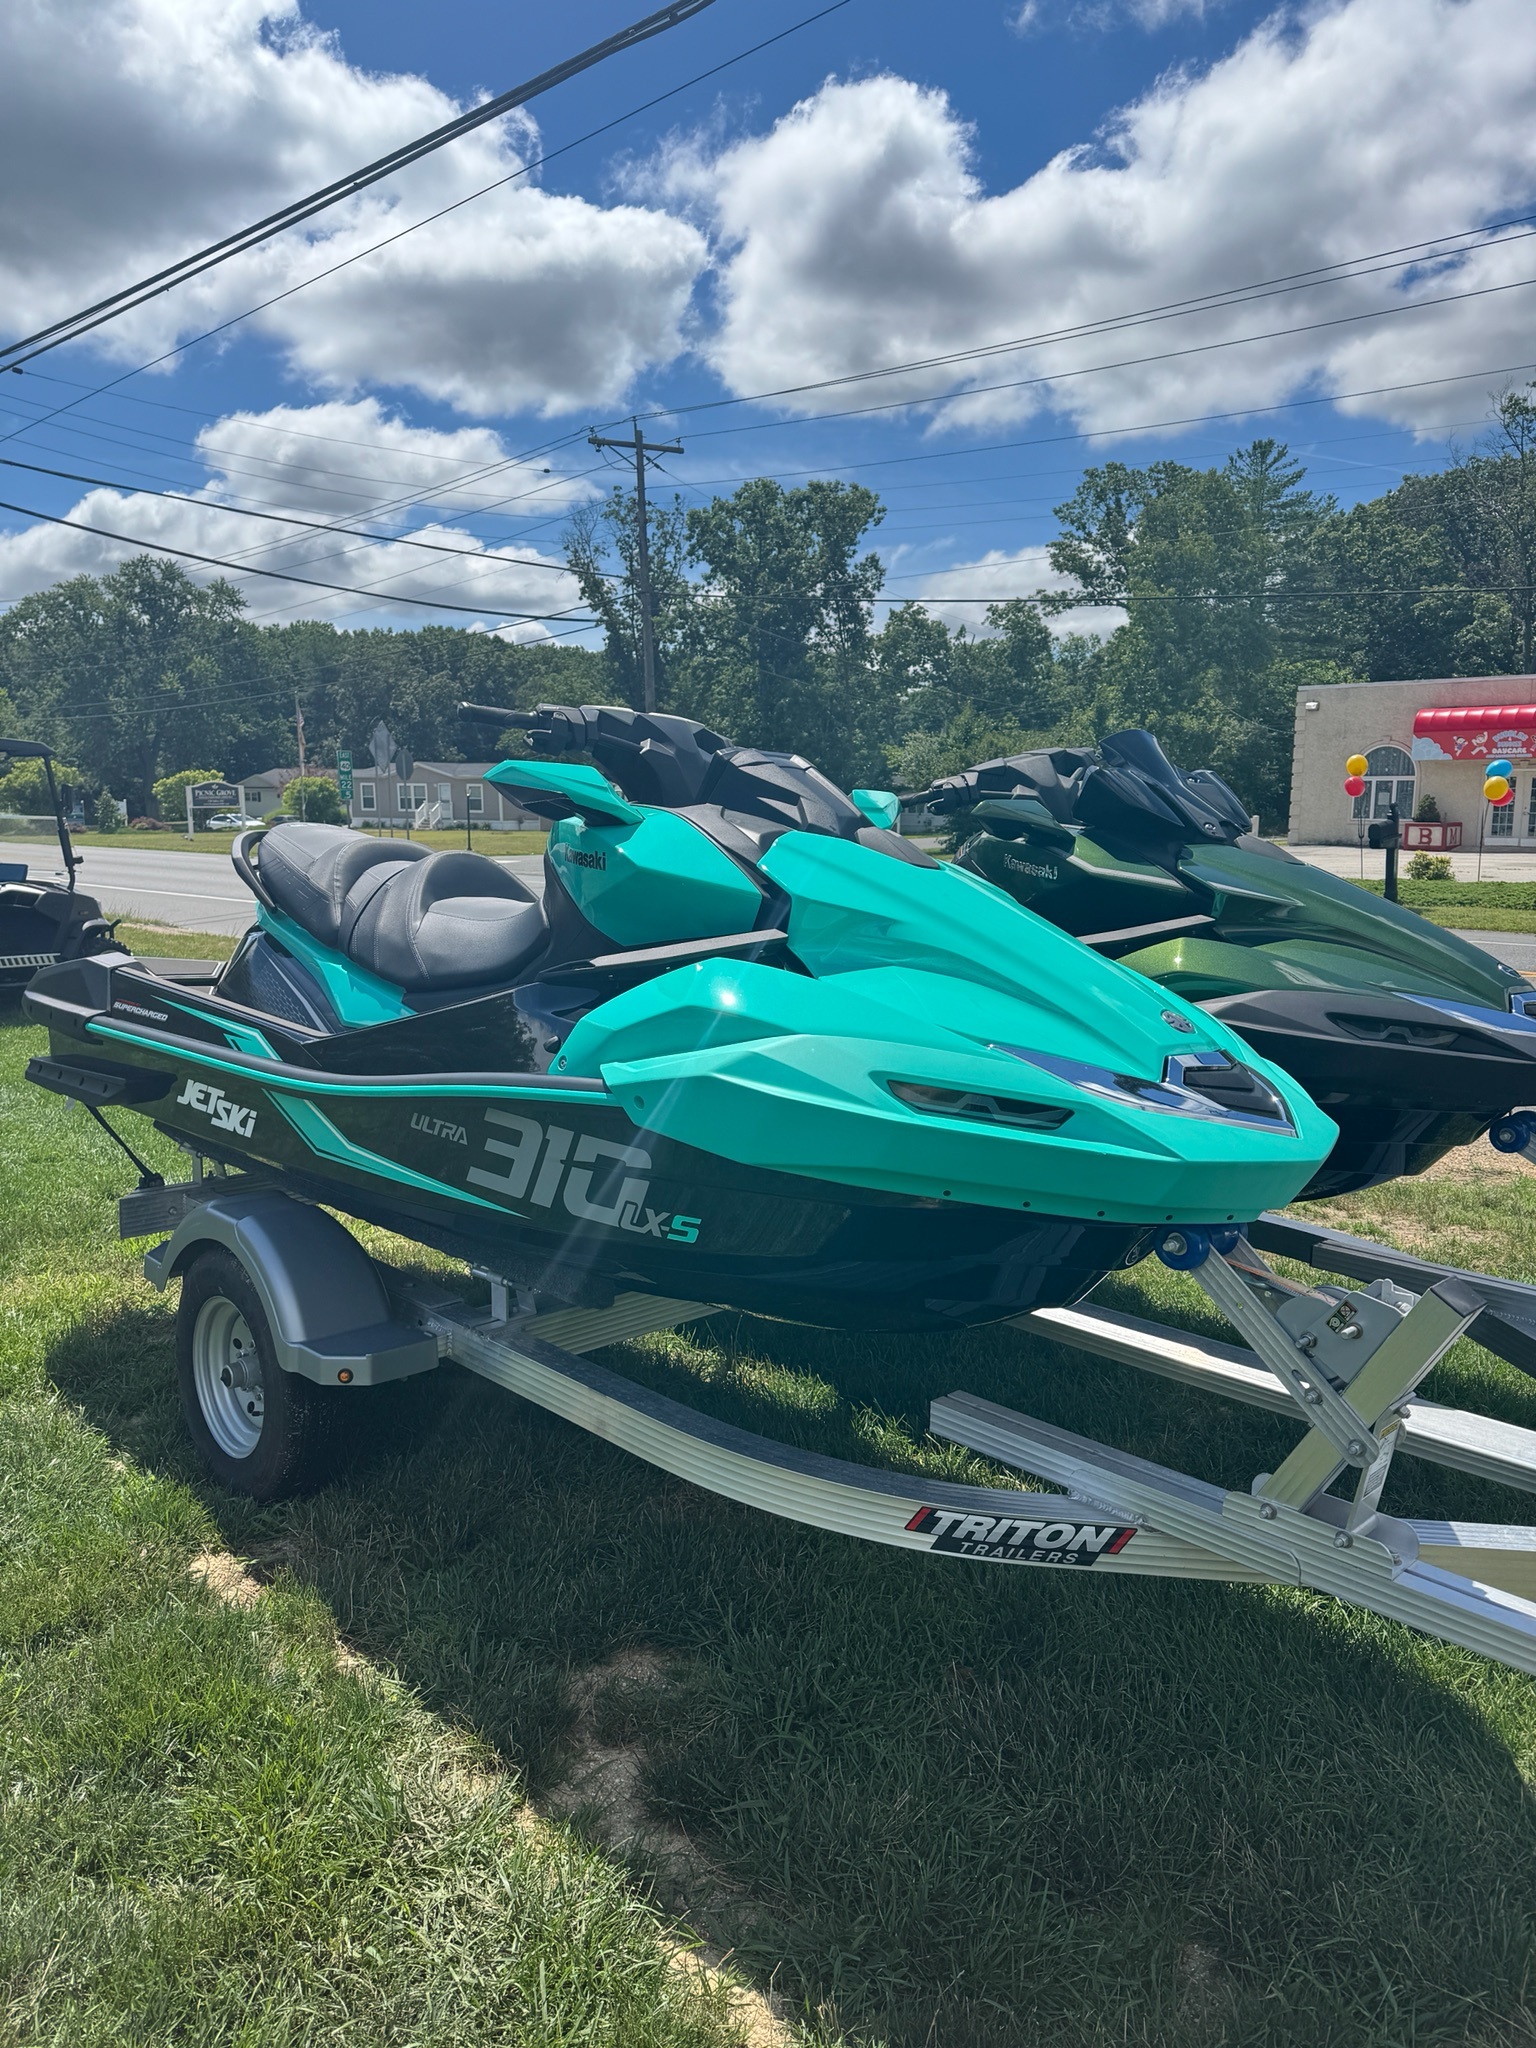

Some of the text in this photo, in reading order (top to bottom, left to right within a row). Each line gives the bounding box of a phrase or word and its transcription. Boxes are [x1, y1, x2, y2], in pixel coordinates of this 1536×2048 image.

[341, 781, 352, 789] 22
[1418, 827, 1433, 845] B
[564, 842, 606, 872] Kawasaki
[1004, 853, 1058, 880] Kawasaki
[112, 1001, 169, 1022] SUPERCHARGED
[410, 1112, 468, 1146] ULTRA
[466, 1107, 652, 1229] 310
[930, 1509, 1117, 1553] TRITON
[960, 1541, 1079, 1565] TRAILERS
